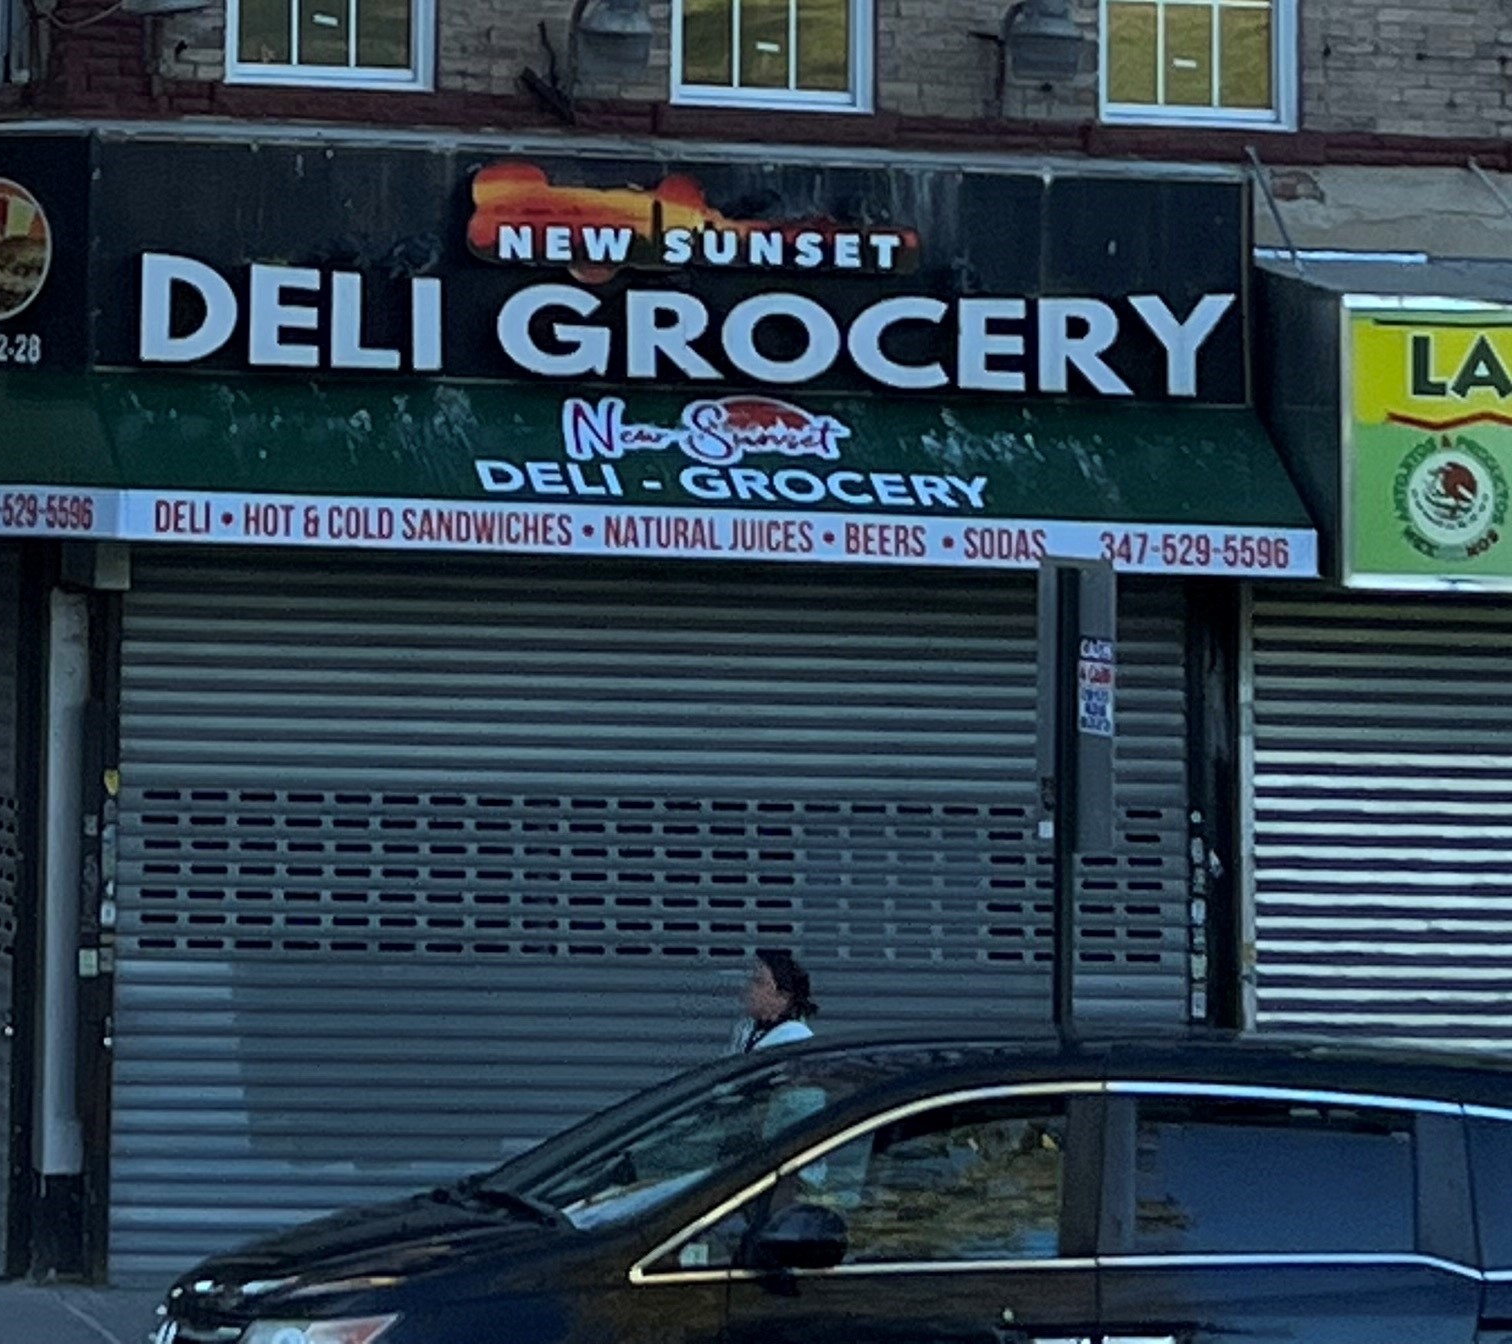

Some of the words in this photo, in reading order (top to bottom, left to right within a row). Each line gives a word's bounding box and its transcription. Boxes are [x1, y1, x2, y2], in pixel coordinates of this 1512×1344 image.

[498, 226, 633, 262] NEW
[662, 228, 902, 269] SUNSET
[139, 252, 442, 371] DELI
[497, 284, 1236, 398] GROCERY
[1410, 333, 1512, 399] LA
[567, 399, 670, 456] New
[686, 401, 842, 462] Sunset
[475, 459, 624, 497] DELI
[678, 465, 988, 508] GROCERY
[154, 500, 211, 533] DELI
[243, 503, 295, 537] HOT
[303, 505, 320, 538] &
[328, 506, 394, 540] COLD
[401, 508, 573, 546] SANDWICHES
[604, 515, 722, 550] NATURAL
[728, 519, 815, 553] JUICES
[844, 522, 927, 557] BEERS
[962, 527, 1049, 562] SODAS
[1100, 530, 1291, 569] 347-529-5596
